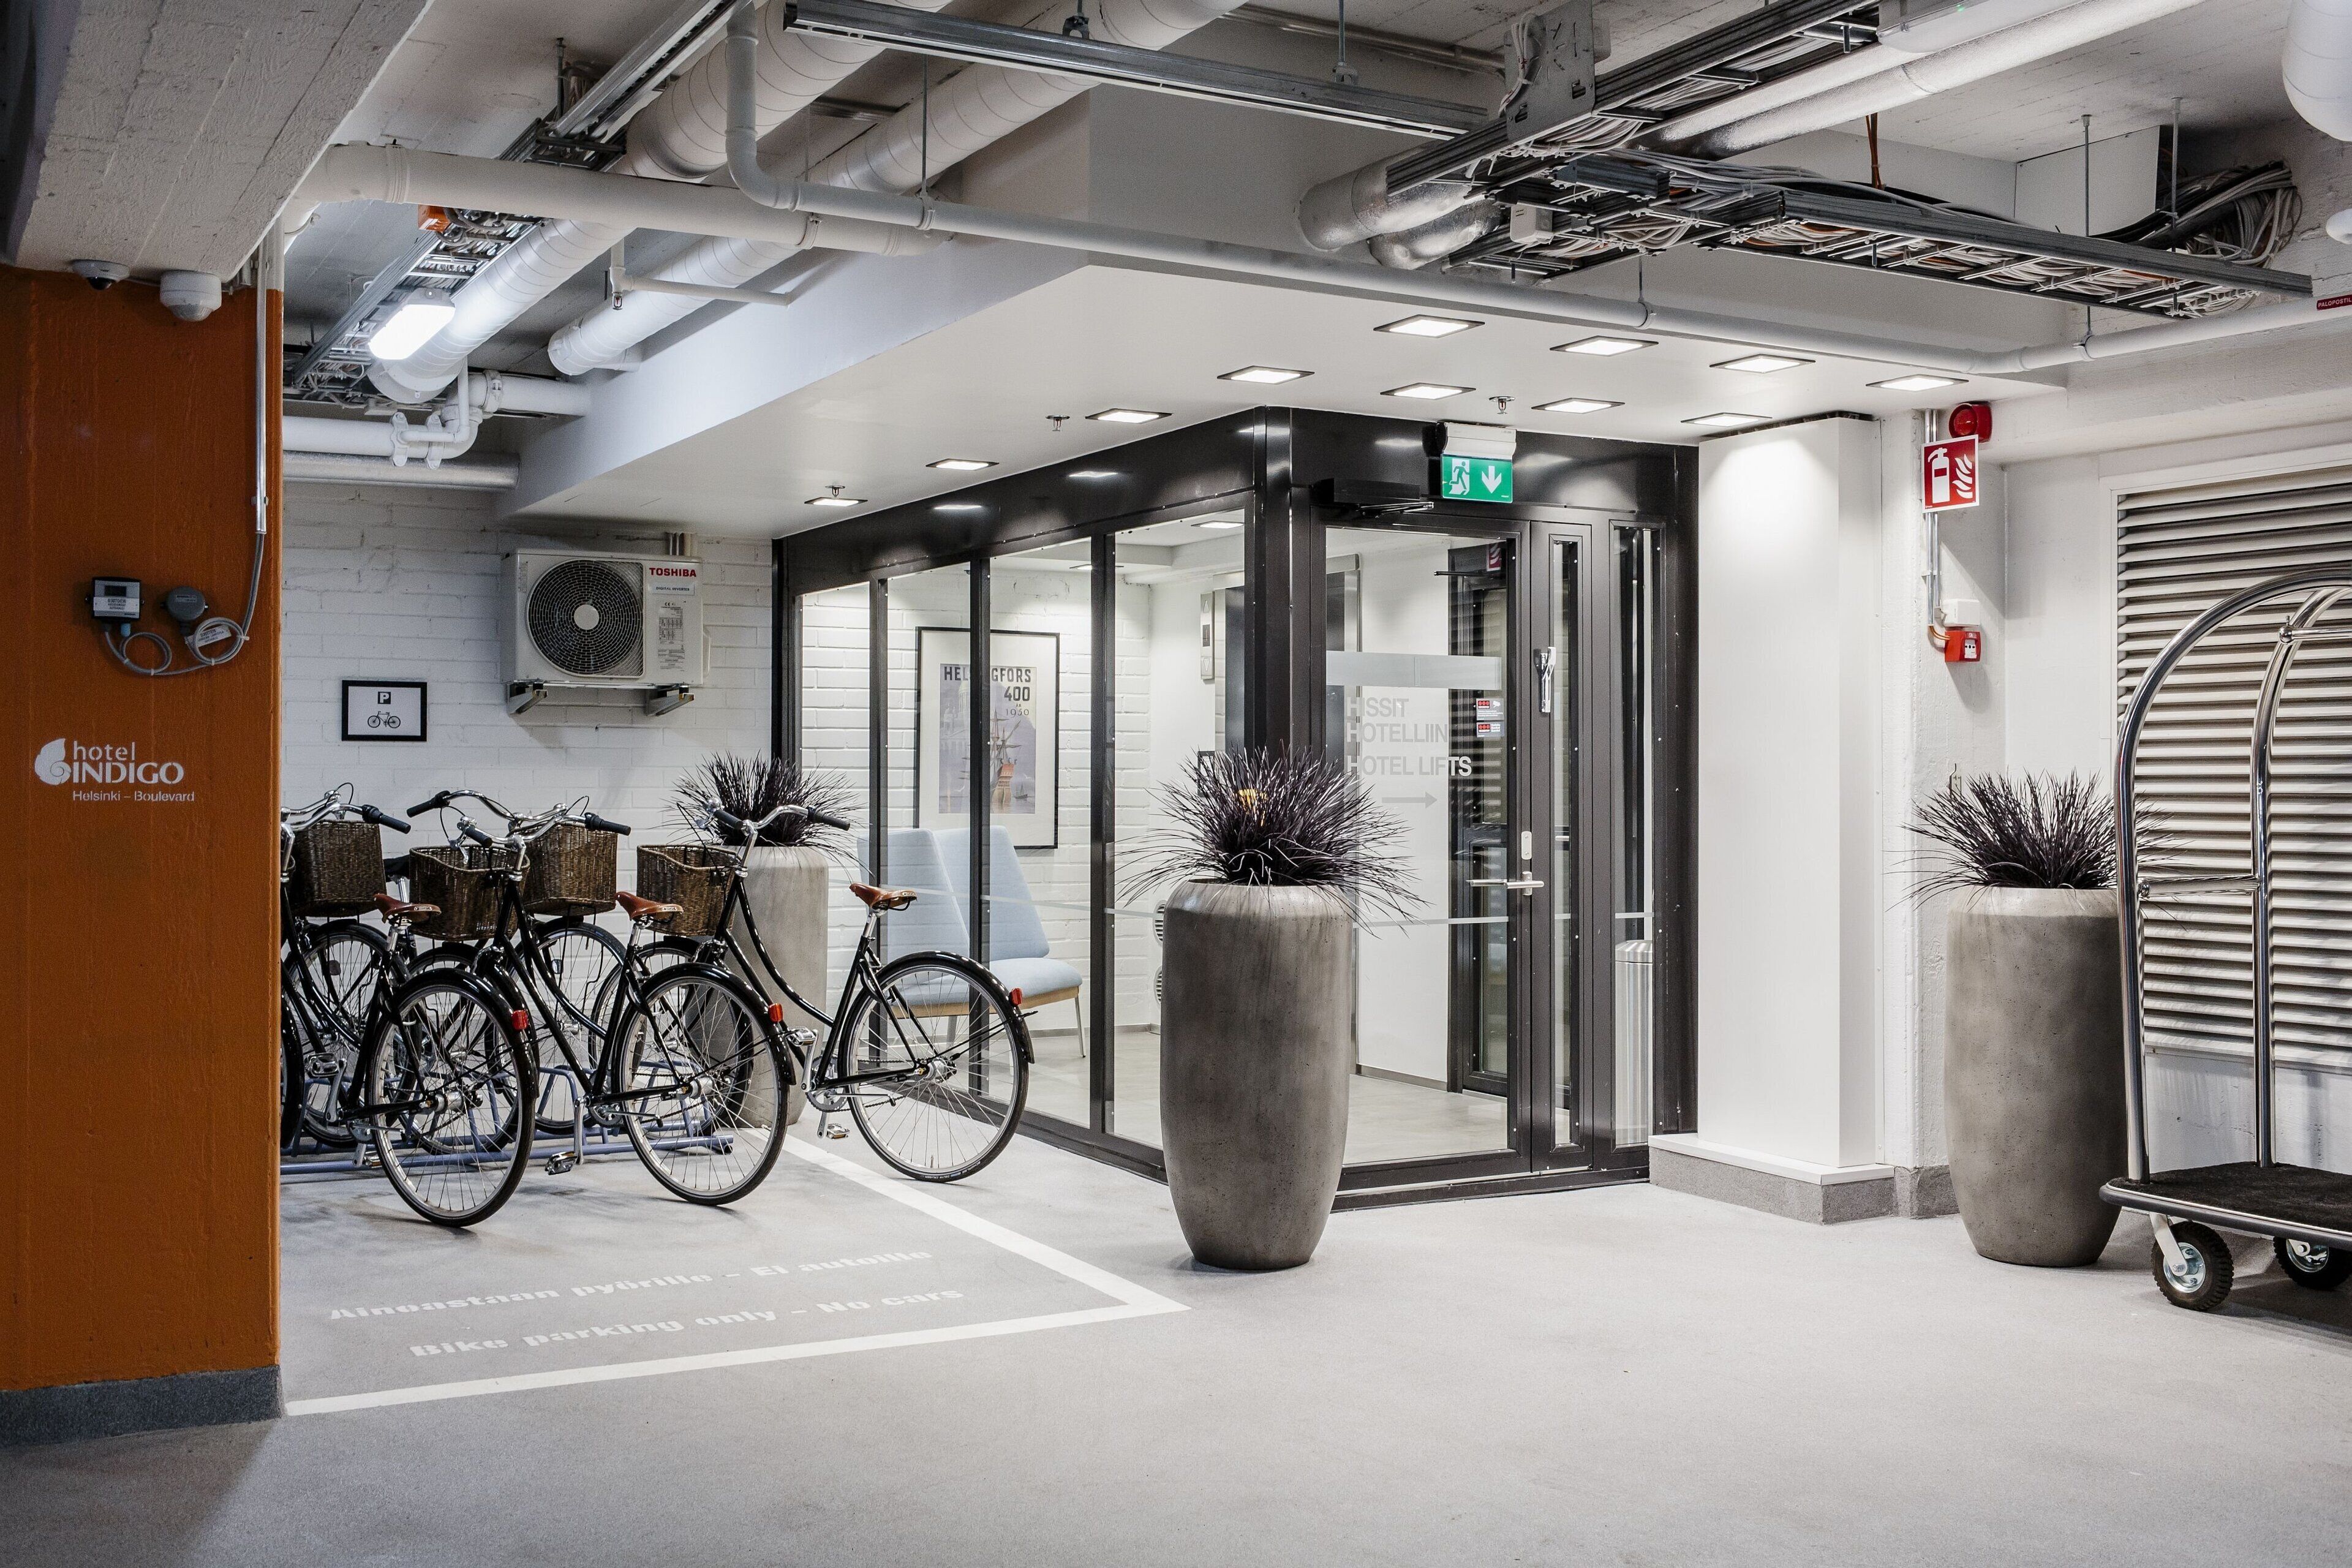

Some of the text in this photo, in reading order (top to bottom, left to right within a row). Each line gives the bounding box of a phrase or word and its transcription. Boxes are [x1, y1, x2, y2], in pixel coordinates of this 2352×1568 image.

[649, 567, 696, 577] TOSHIBA
[944, 666, 1031, 682] HELGFORS
[380, 693, 390, 703] P
[1004, 686, 1030, 701] 400
[1006, 709, 1030, 718] 1950
[1347, 697, 1409, 717] HISSIT
[1347, 723, 1447, 742] HOTELLIIN
[74, 741, 135, 760] hotel
[73, 762, 184, 785] INDIGO
[1347, 755, 1472, 777] HOTEL LIFTS
[73, 791, 121, 801] Helsinki
[134, 791, 195, 802] Boulevard
[331, 1290, 560, 1319] Ainoastaan
[570, 1273, 713, 1297] pyörille
[749, 1265, 790, 1276] Ei
[797, 1251, 933, 1272] autoille
[409, 1340, 509, 1357] Bike
[522, 1319, 685, 1346] parking
[695, 1311, 777, 1326] only
[816, 1300, 871, 1313] No
[880, 1289, 965, 1306] cars
